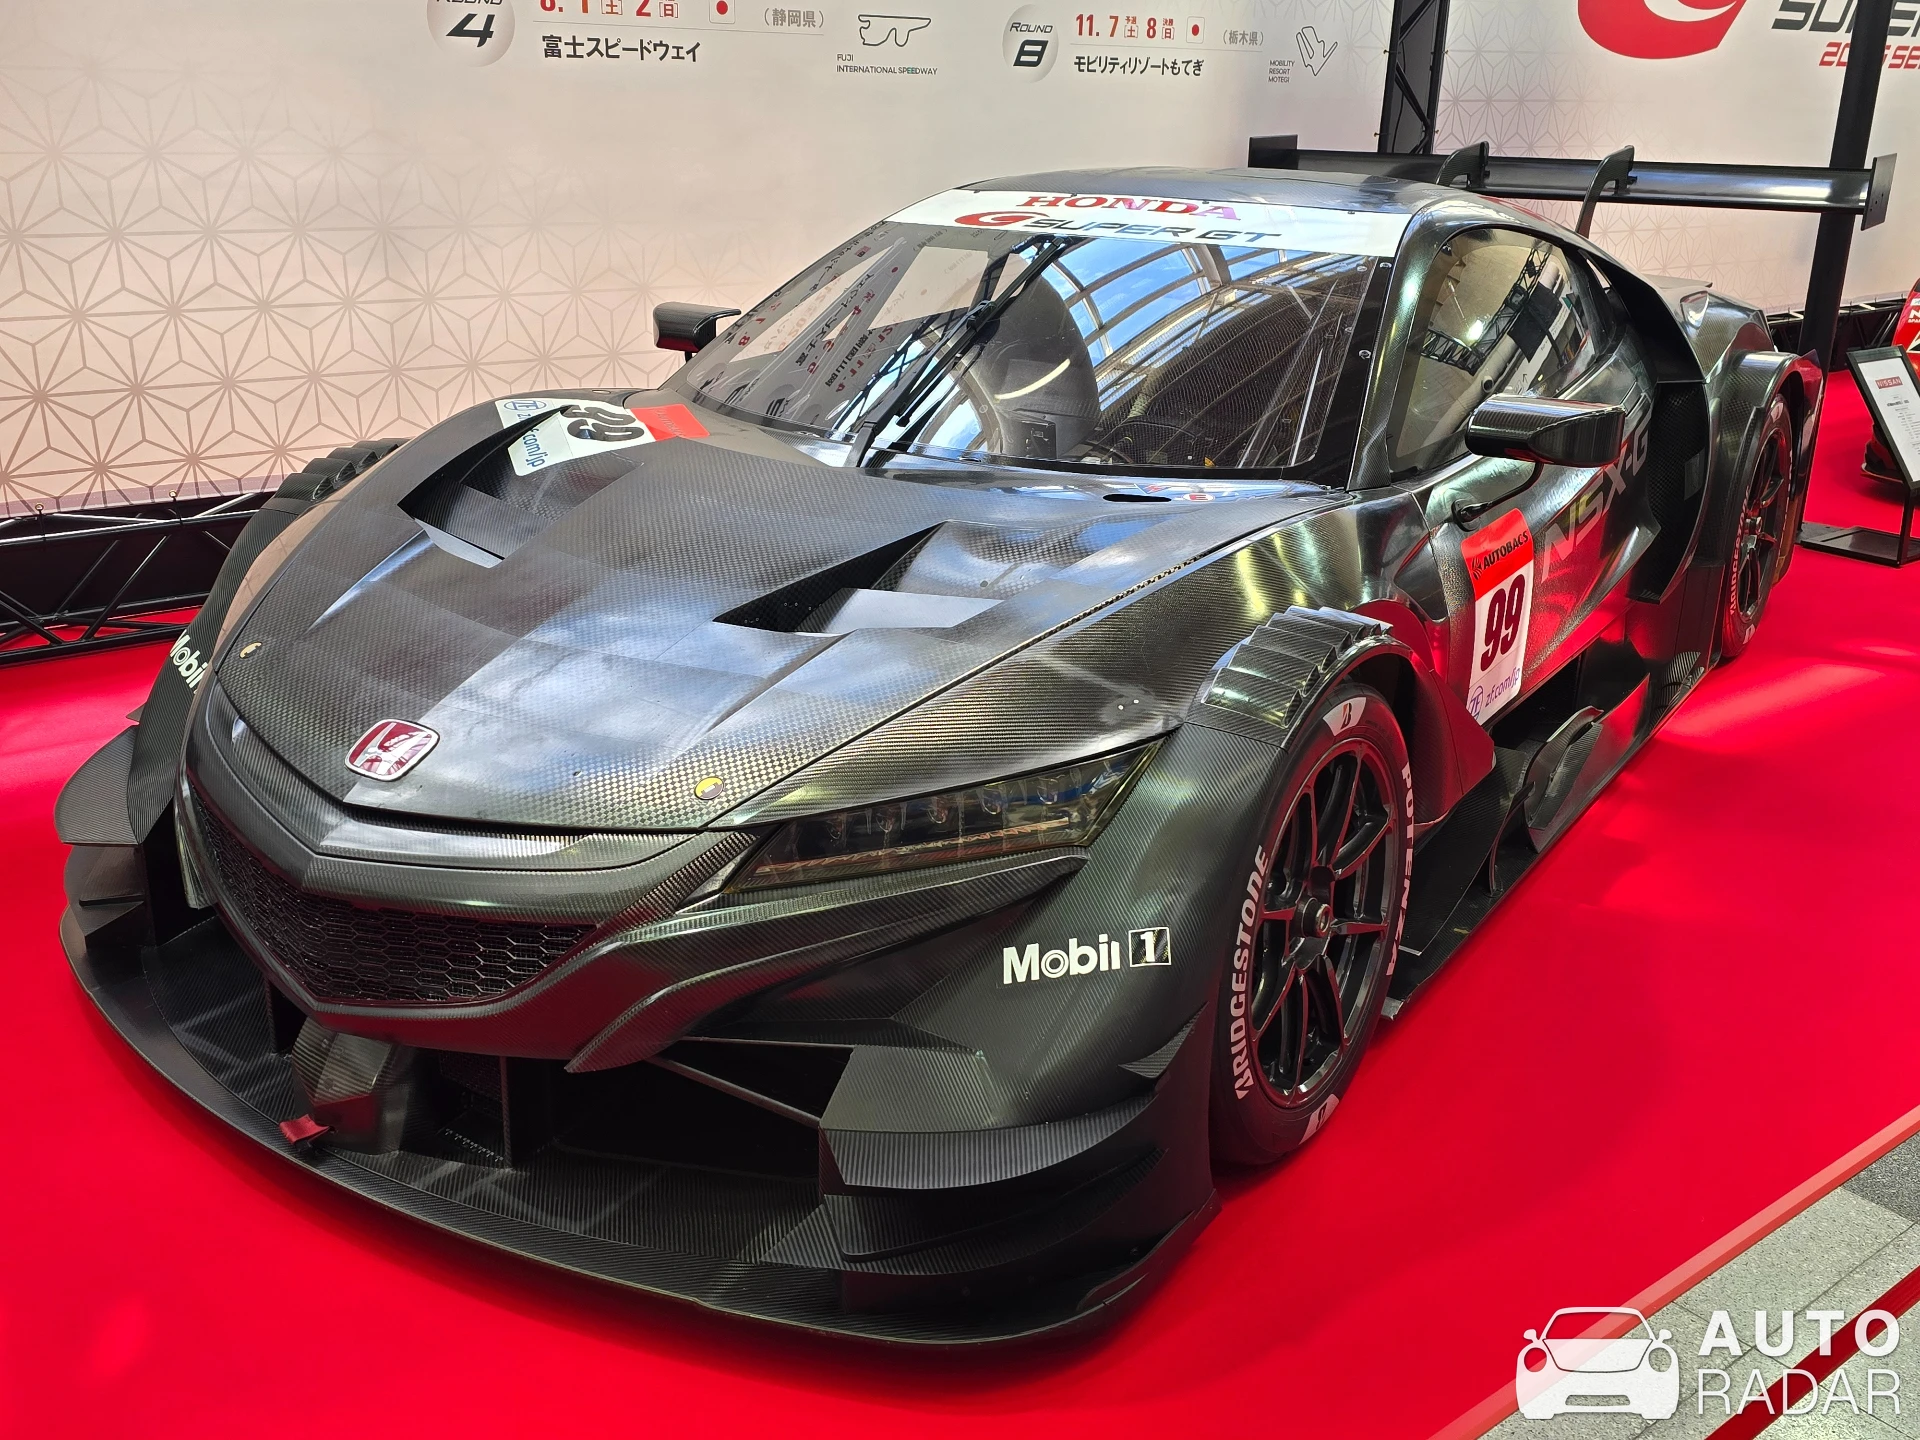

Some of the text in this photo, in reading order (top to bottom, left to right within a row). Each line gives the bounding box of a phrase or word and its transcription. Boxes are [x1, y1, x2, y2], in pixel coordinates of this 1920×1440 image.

[446, 13, 496, 47] 4
[542, 34, 700, 62] 富士スピードウェイ
[836, 54, 854, 62] FUJI
[836, 65, 938, 75] INTERNATIONAL SPEEDWAY
[1074, 55, 1204, 76] モビリティリゾートもてぎ
[1016, 196, 1242, 220] HONDA
[1023, 219, 1282, 244] SUPER GT
[1876, 378, 1902, 388] NISSAN
[1483, 530, 1529, 571] AUTOBACS
[1480, 574, 1526, 672] 99
[1386, 761, 1414, 976] POTENZA
[1003, 933, 1121, 984] Mobil
[1230, 845, 1269, 1100] BRIDGESTONE
